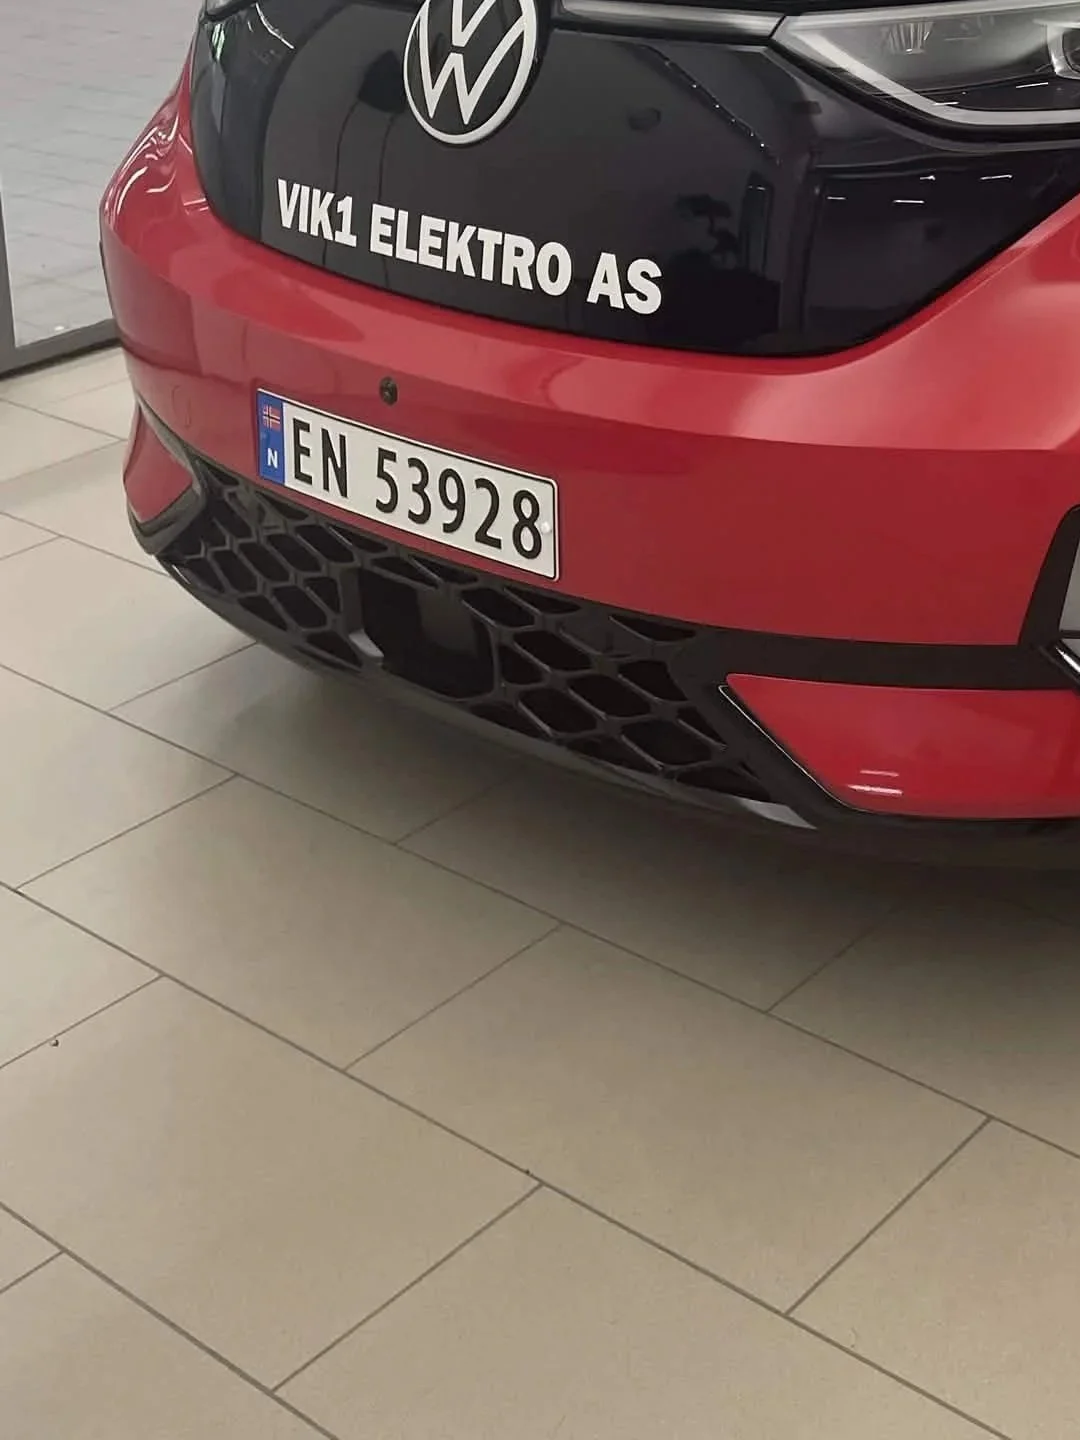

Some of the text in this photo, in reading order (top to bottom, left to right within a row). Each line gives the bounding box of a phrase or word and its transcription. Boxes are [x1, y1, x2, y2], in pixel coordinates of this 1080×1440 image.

[277, 178, 663, 316] VIK1 ELEKTRO AS
[266, 447, 279, 469] N
[292, 417, 543, 560] EN 53928
